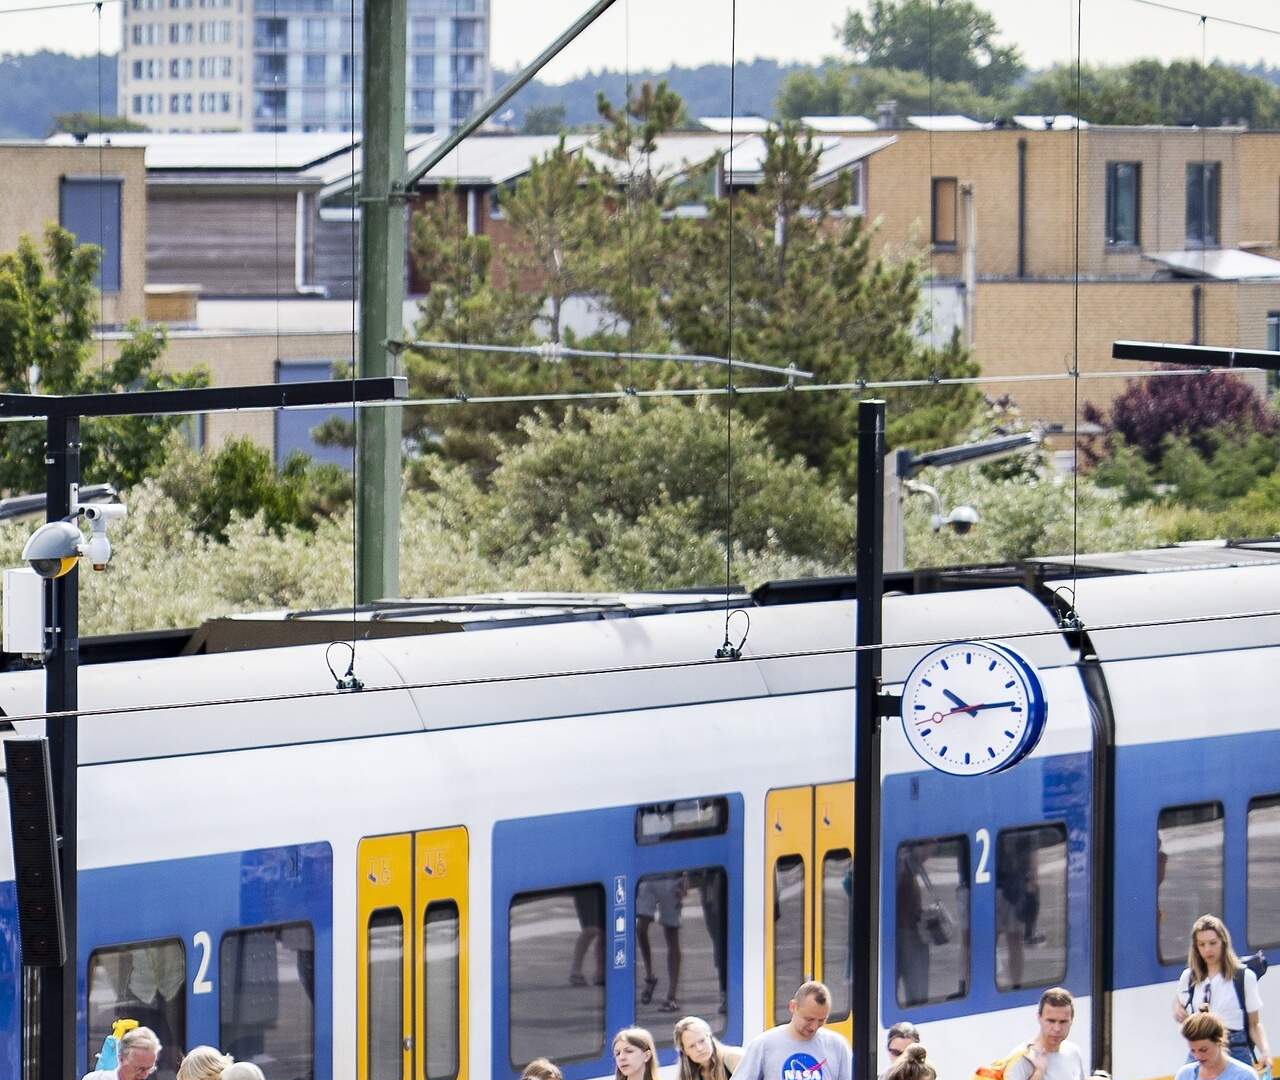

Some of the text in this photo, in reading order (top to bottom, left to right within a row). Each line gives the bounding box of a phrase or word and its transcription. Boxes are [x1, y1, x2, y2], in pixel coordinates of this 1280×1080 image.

[975, 828, 991, 884] 2
[192, 931, 212, 995] 2
[784, 1069, 822, 1080] NASA
